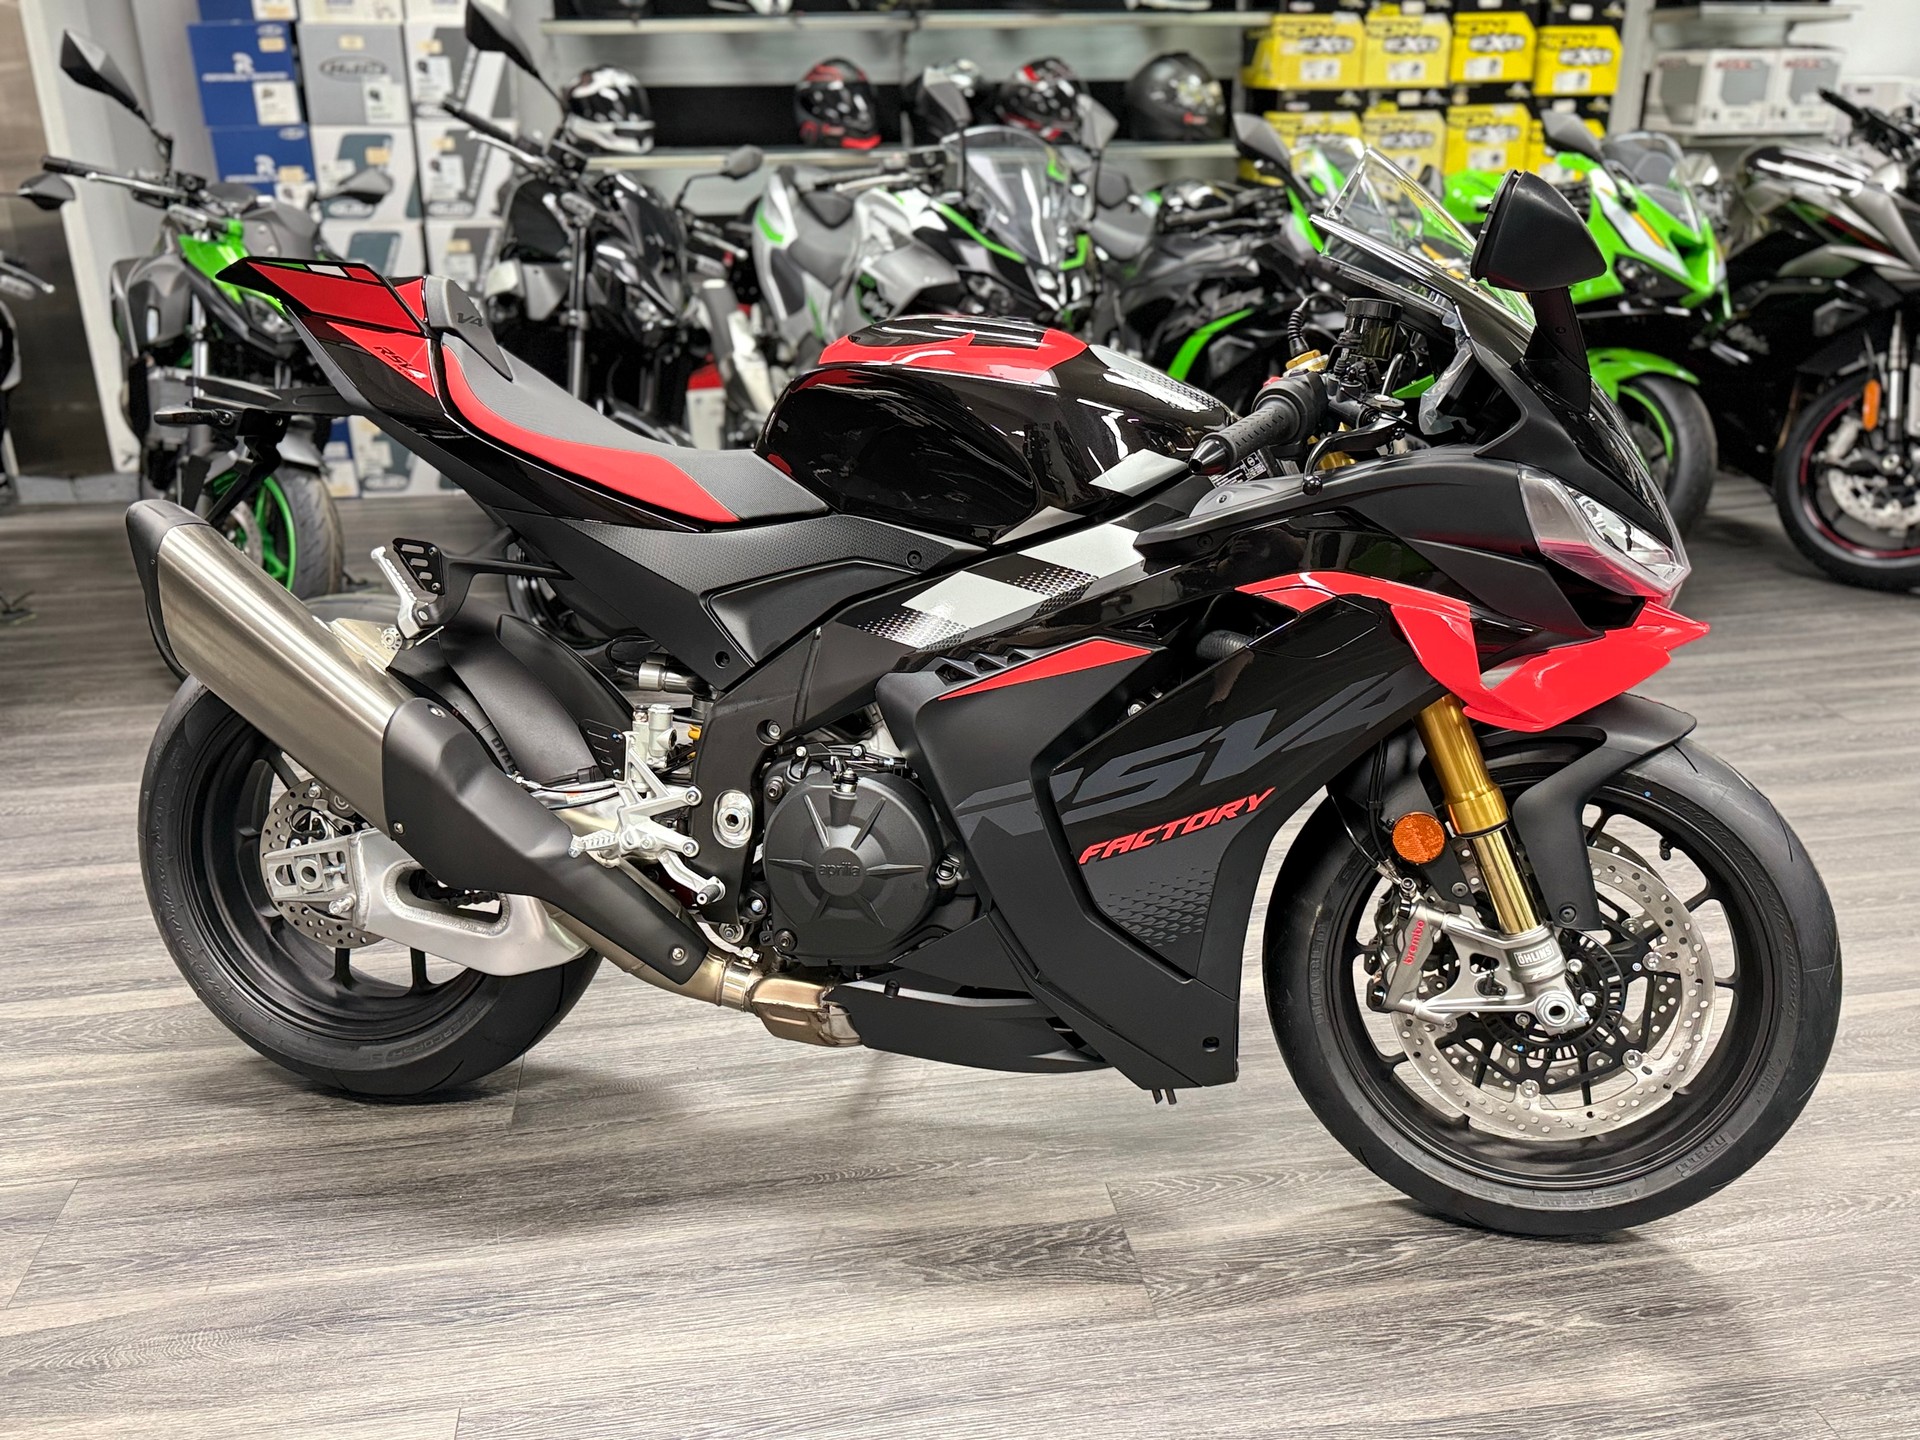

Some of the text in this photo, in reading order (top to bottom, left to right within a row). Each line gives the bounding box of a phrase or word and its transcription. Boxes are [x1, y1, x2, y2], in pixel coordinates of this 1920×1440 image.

[457, 312, 483, 327] V4
[1079, 787, 1276, 865] FACTORY
[819, 861, 861, 878] aprilia
[1403, 920, 1426, 965] brembo
[1518, 947, 1553, 966] ÖHLINS
